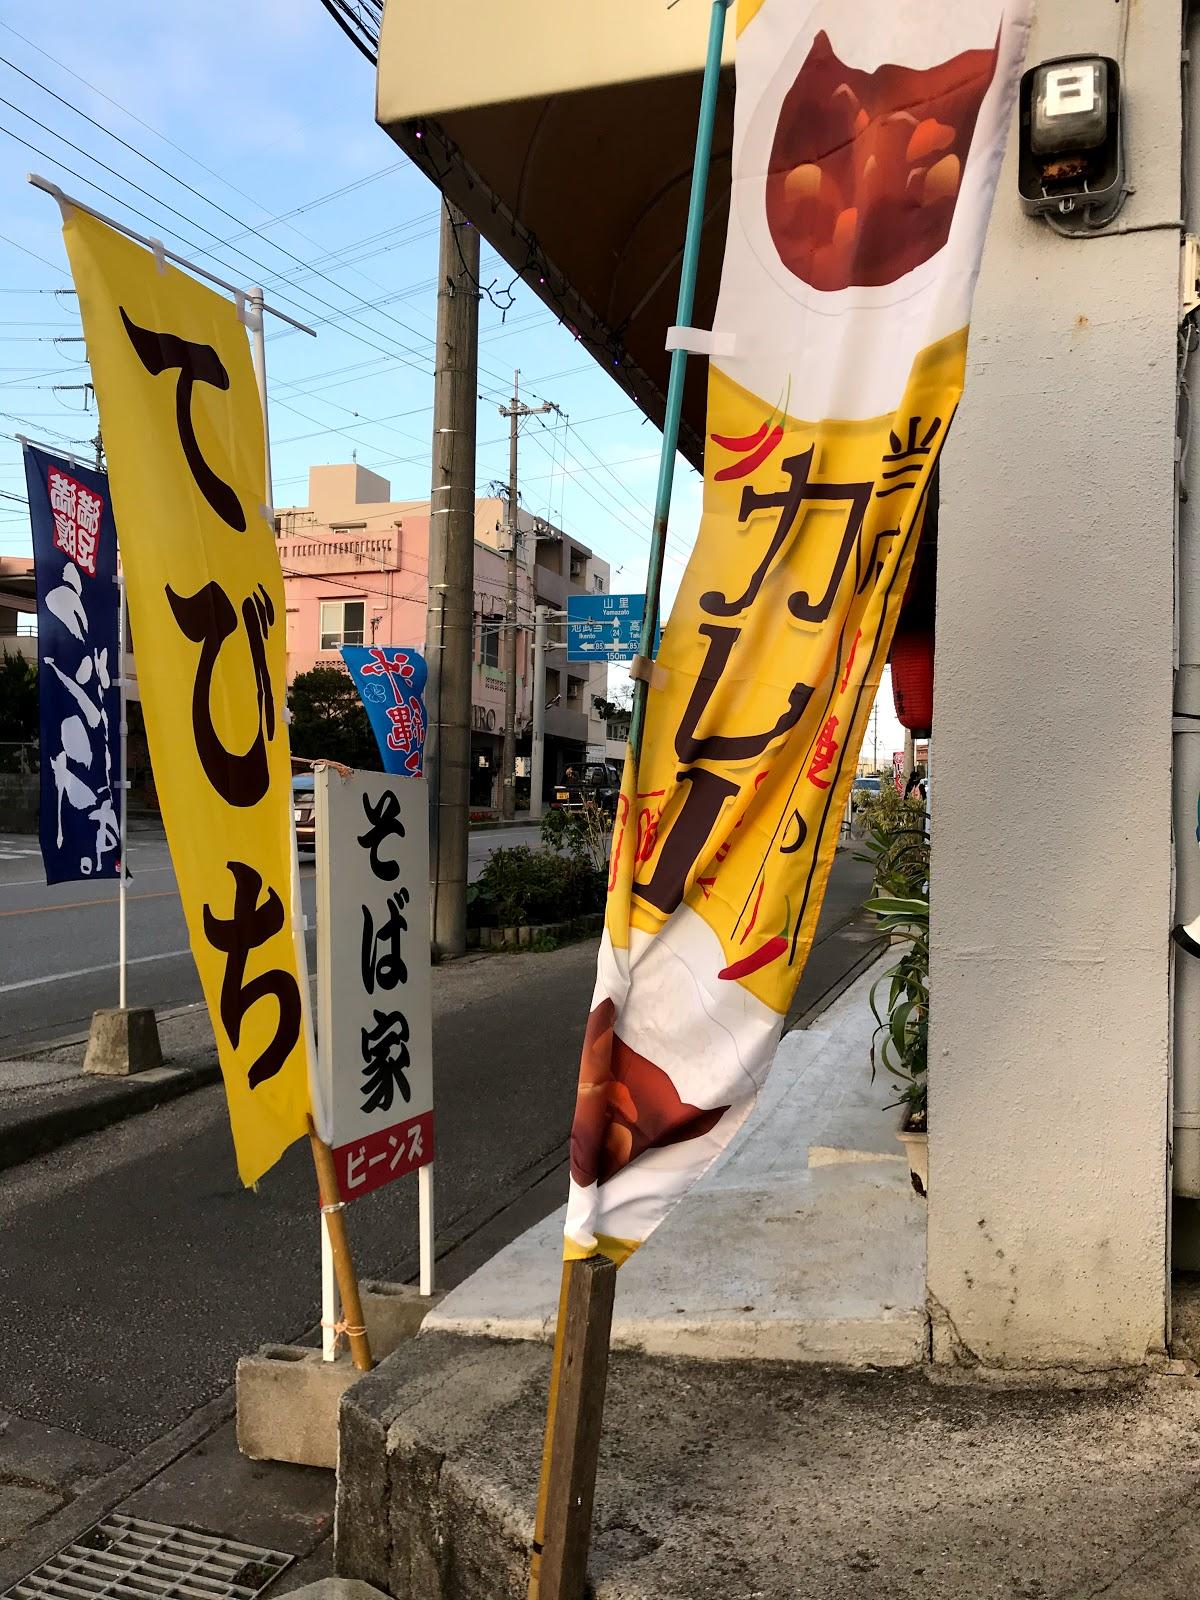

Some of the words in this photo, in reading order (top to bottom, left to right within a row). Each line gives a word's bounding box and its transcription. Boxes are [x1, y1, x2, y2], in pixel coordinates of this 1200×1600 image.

[603, 597, 629, 609] 山里
[629, 620, 641, 632] 高
[612, 628, 620, 637] 24
[595, 642, 604, 650] 85
[628, 642, 638, 650] 85
[632, 443, 875, 914] カレー
[120, 306, 303, 1087] てびち
[357, 790, 411, 1114] そば家
[347, 1123, 424, 1189] ビーンズ
